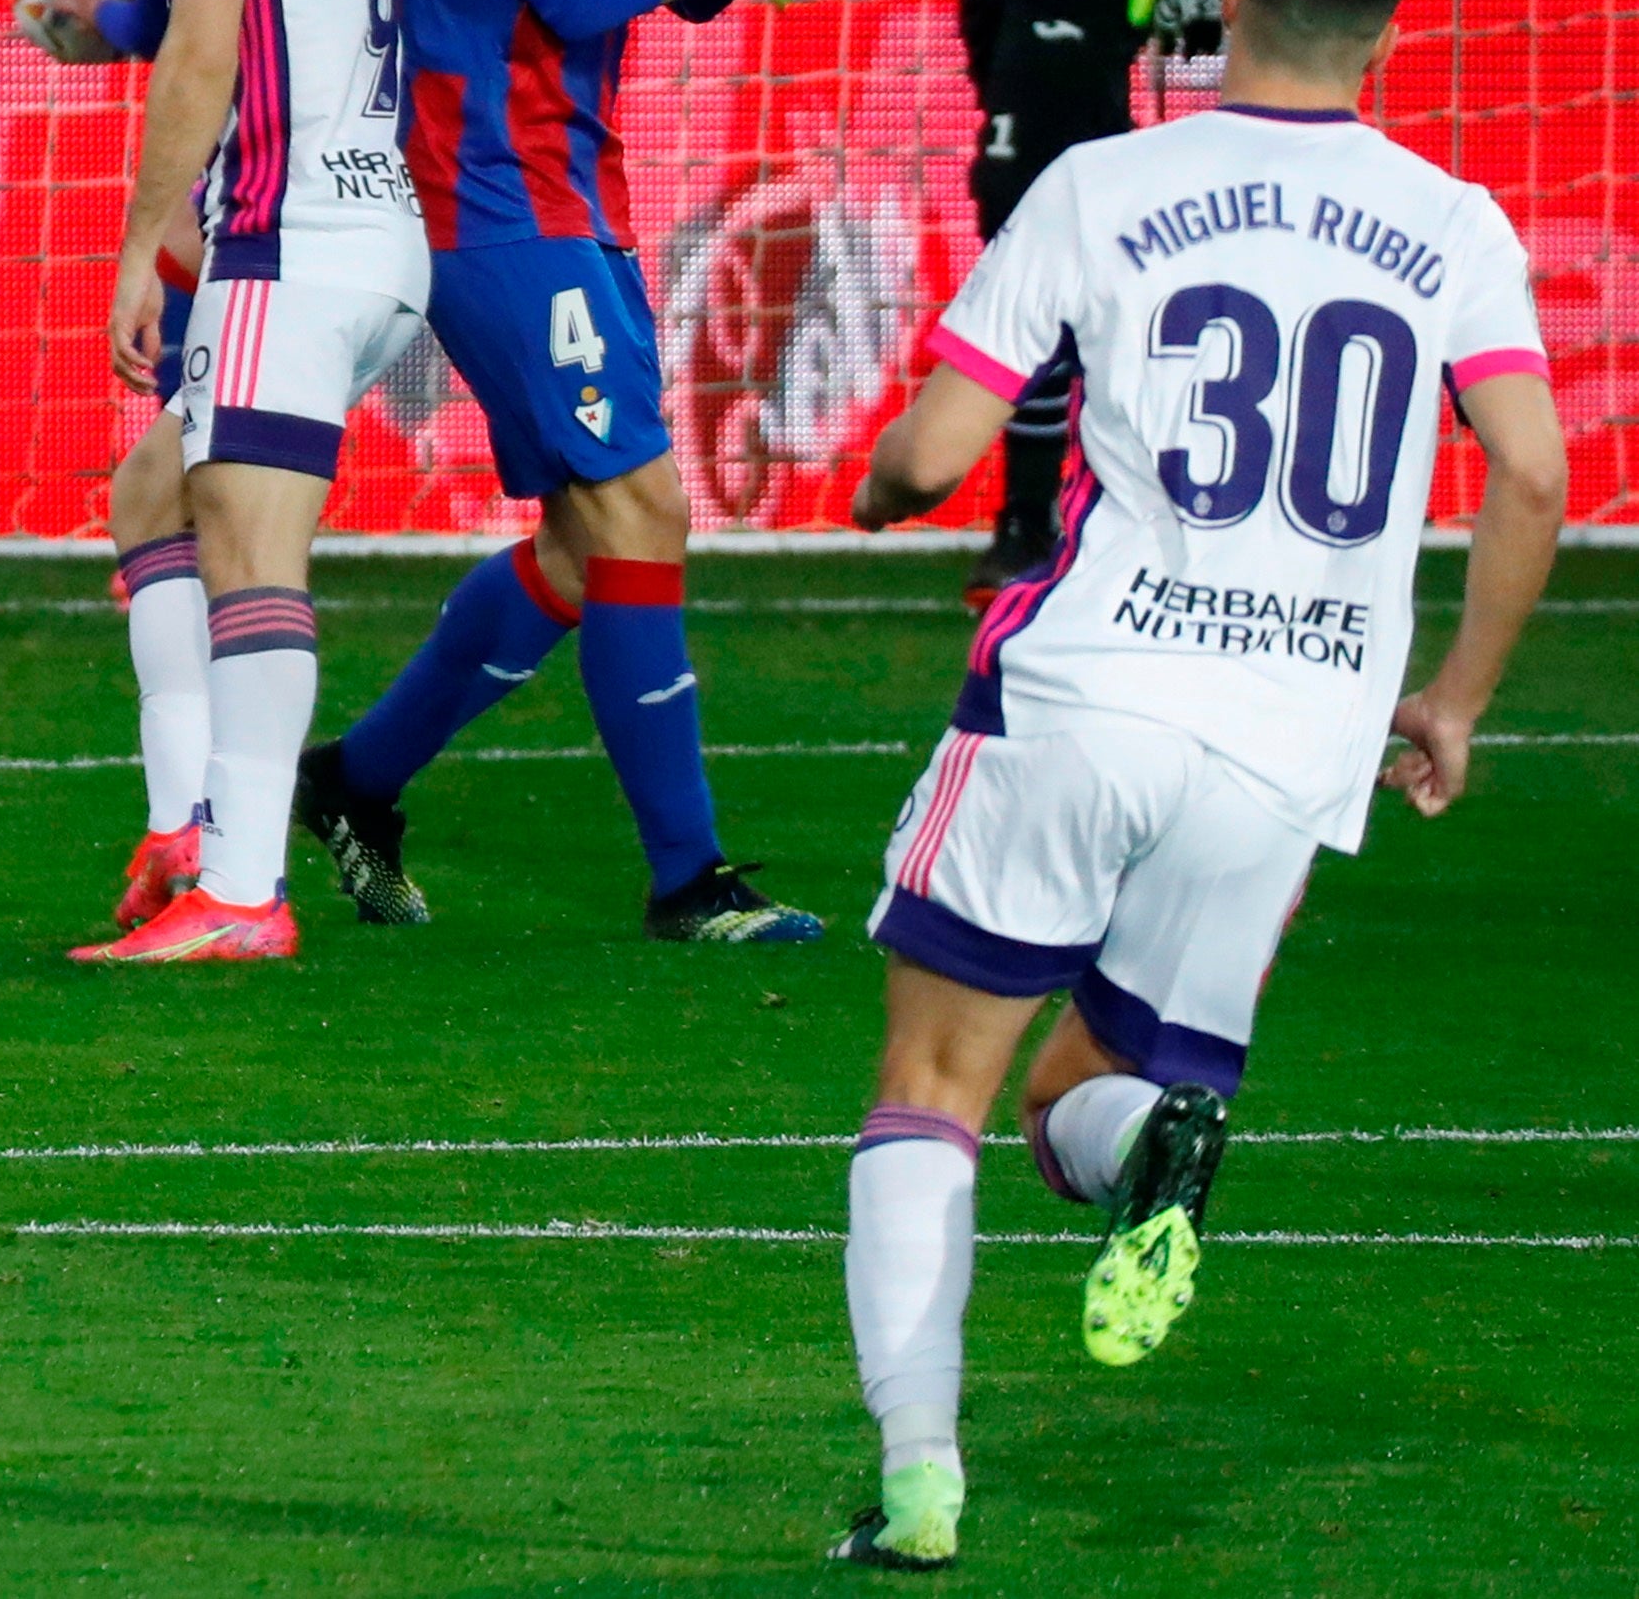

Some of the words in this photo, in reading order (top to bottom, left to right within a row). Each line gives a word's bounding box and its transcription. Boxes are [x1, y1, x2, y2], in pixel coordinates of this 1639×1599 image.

[985, 114, 1015, 158] 1
[1115, 182, 1294, 272] MIGUEL
[1308, 196, 1445, 299] RUBIO
[550, 288, 606, 373] 4
[1148, 282, 1419, 548] 30
